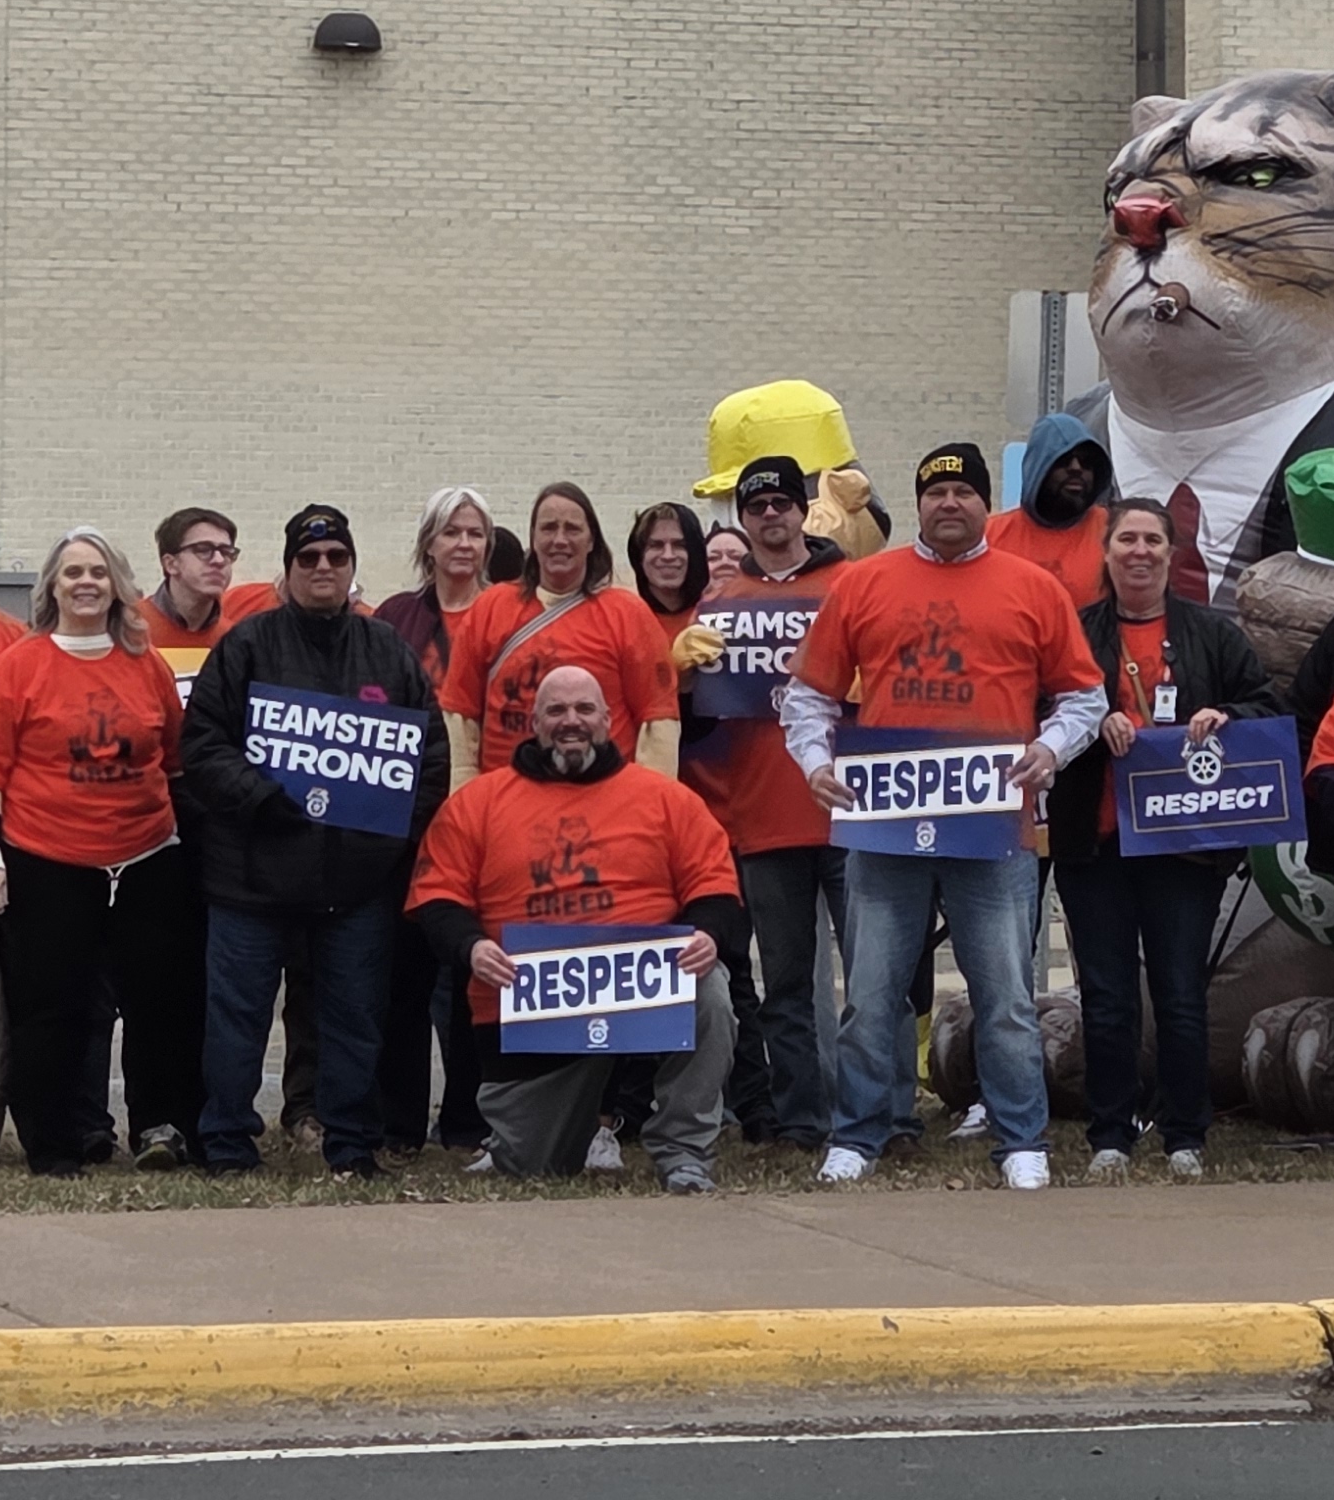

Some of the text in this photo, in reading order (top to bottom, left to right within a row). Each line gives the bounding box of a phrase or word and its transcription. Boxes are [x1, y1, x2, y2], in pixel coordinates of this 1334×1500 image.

[892, 677, 974, 704] GREED
[250, 697, 422, 755] TEAMSTER
[245, 735, 414, 791] STRONG
[846, 754, 1014, 812] RESPECT
[1145, 785, 1274, 817] RESPECT
[513, 946, 685, 1013] RESPECT
